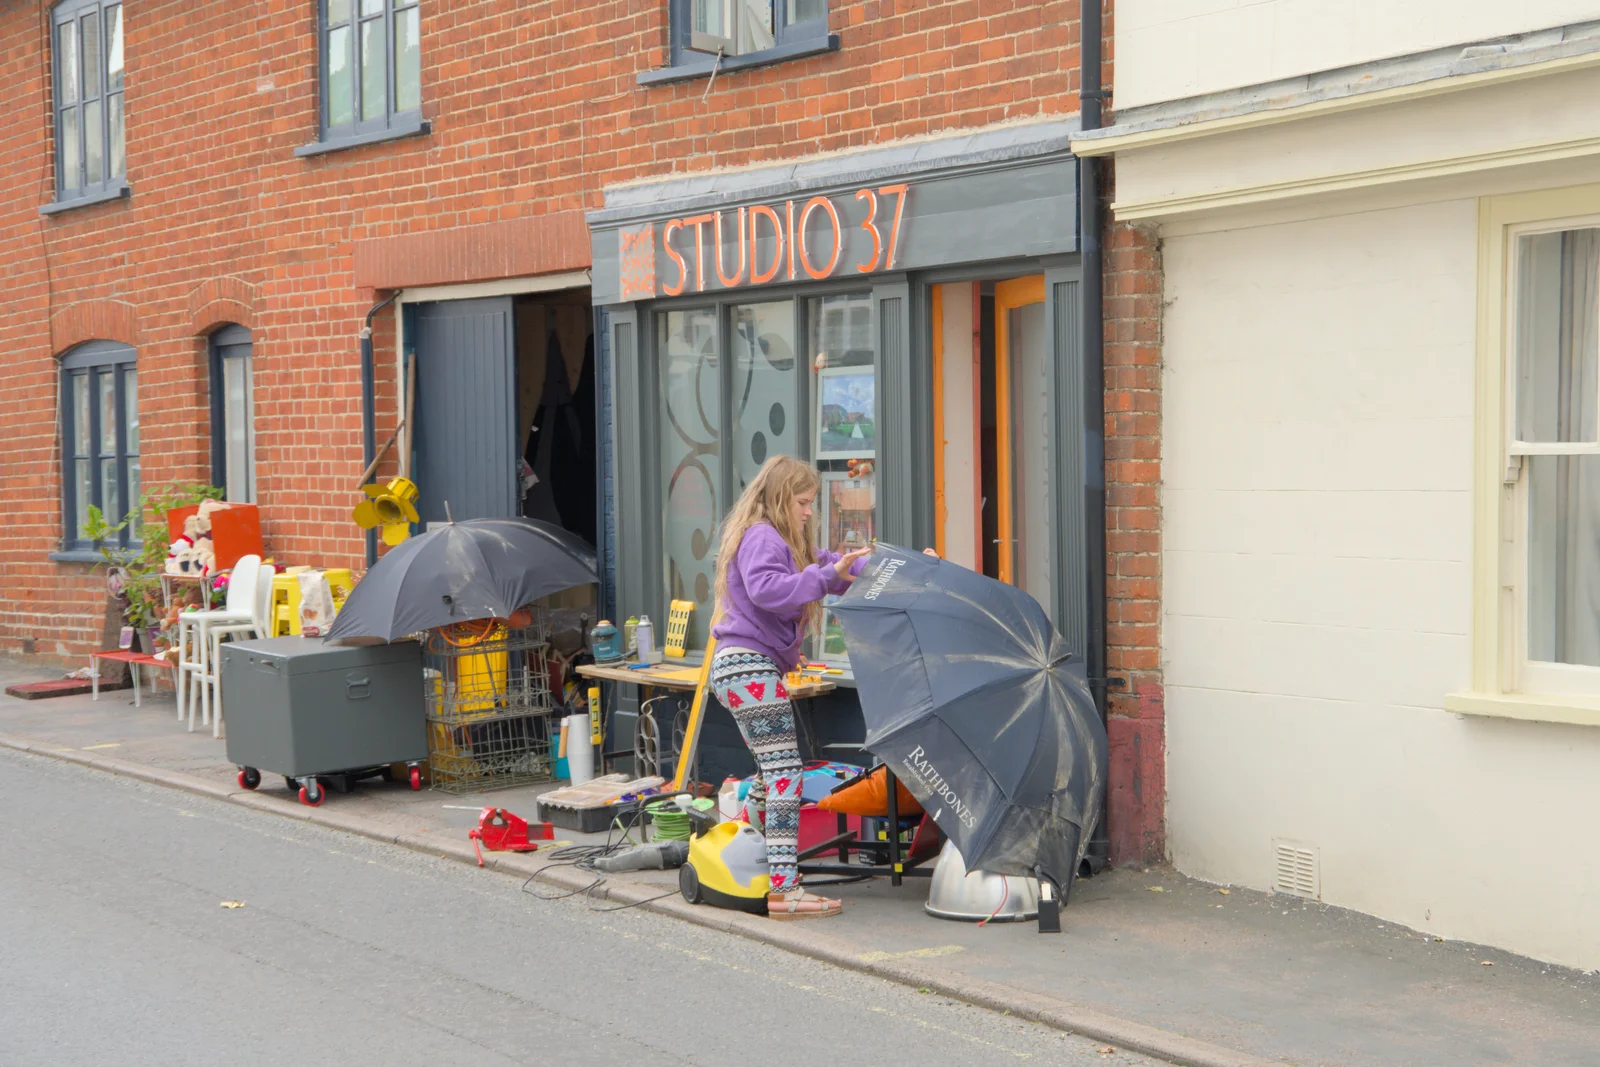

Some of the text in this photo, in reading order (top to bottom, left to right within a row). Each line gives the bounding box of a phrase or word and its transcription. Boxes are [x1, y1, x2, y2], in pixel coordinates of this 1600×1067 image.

[663, 184, 908, 296] STUDIO 37
[864, 558, 906, 600] RATHBONES
[902, 758, 926, 786] Established
[907, 744, 977, 828] RATHBONES
